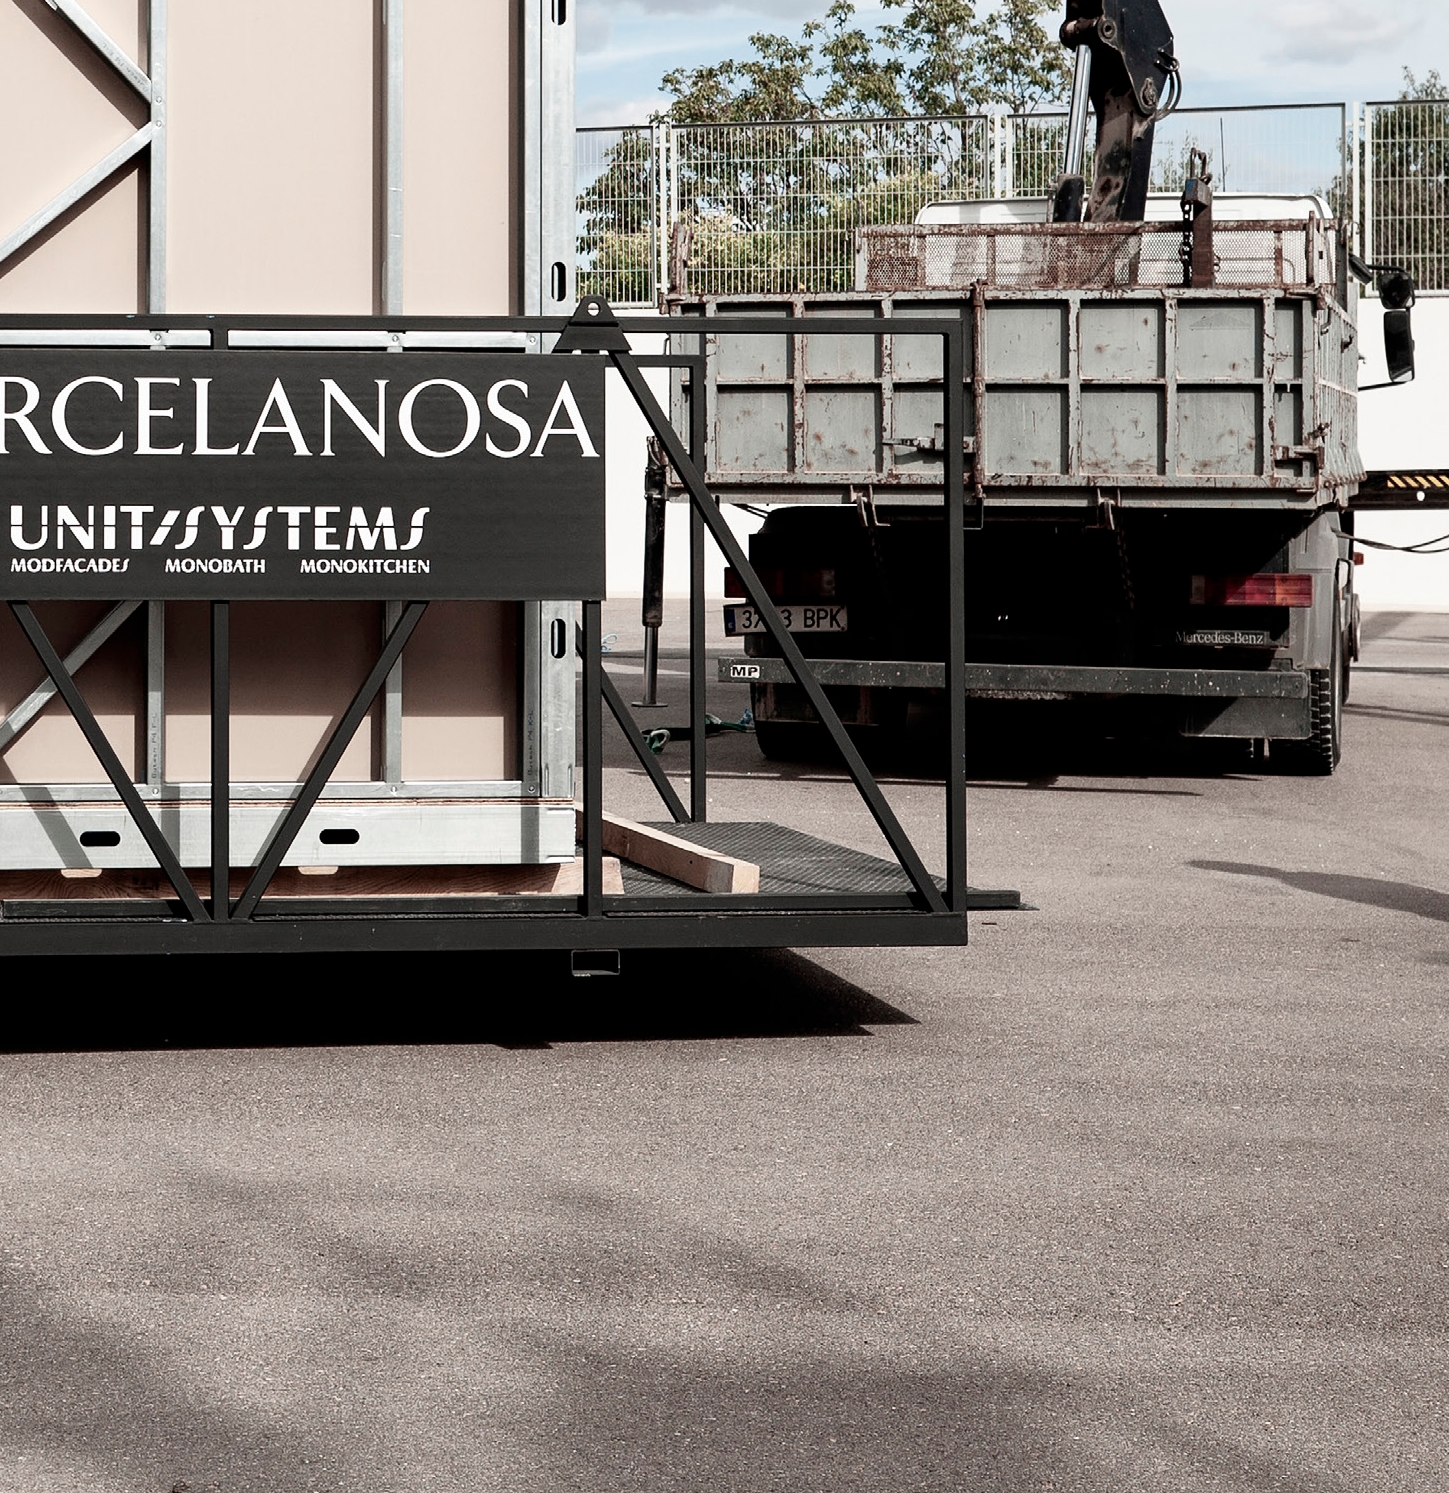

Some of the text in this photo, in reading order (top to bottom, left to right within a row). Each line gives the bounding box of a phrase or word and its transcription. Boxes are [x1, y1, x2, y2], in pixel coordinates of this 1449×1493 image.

[11, 558, 430, 574] MODFACADES MONOBATH MONOKITCHEN
[742, 608, 842, 629] 373 BPK
[1175, 630, 1264, 644] Mercedes-Benz
[732, 666, 758, 676] MP
